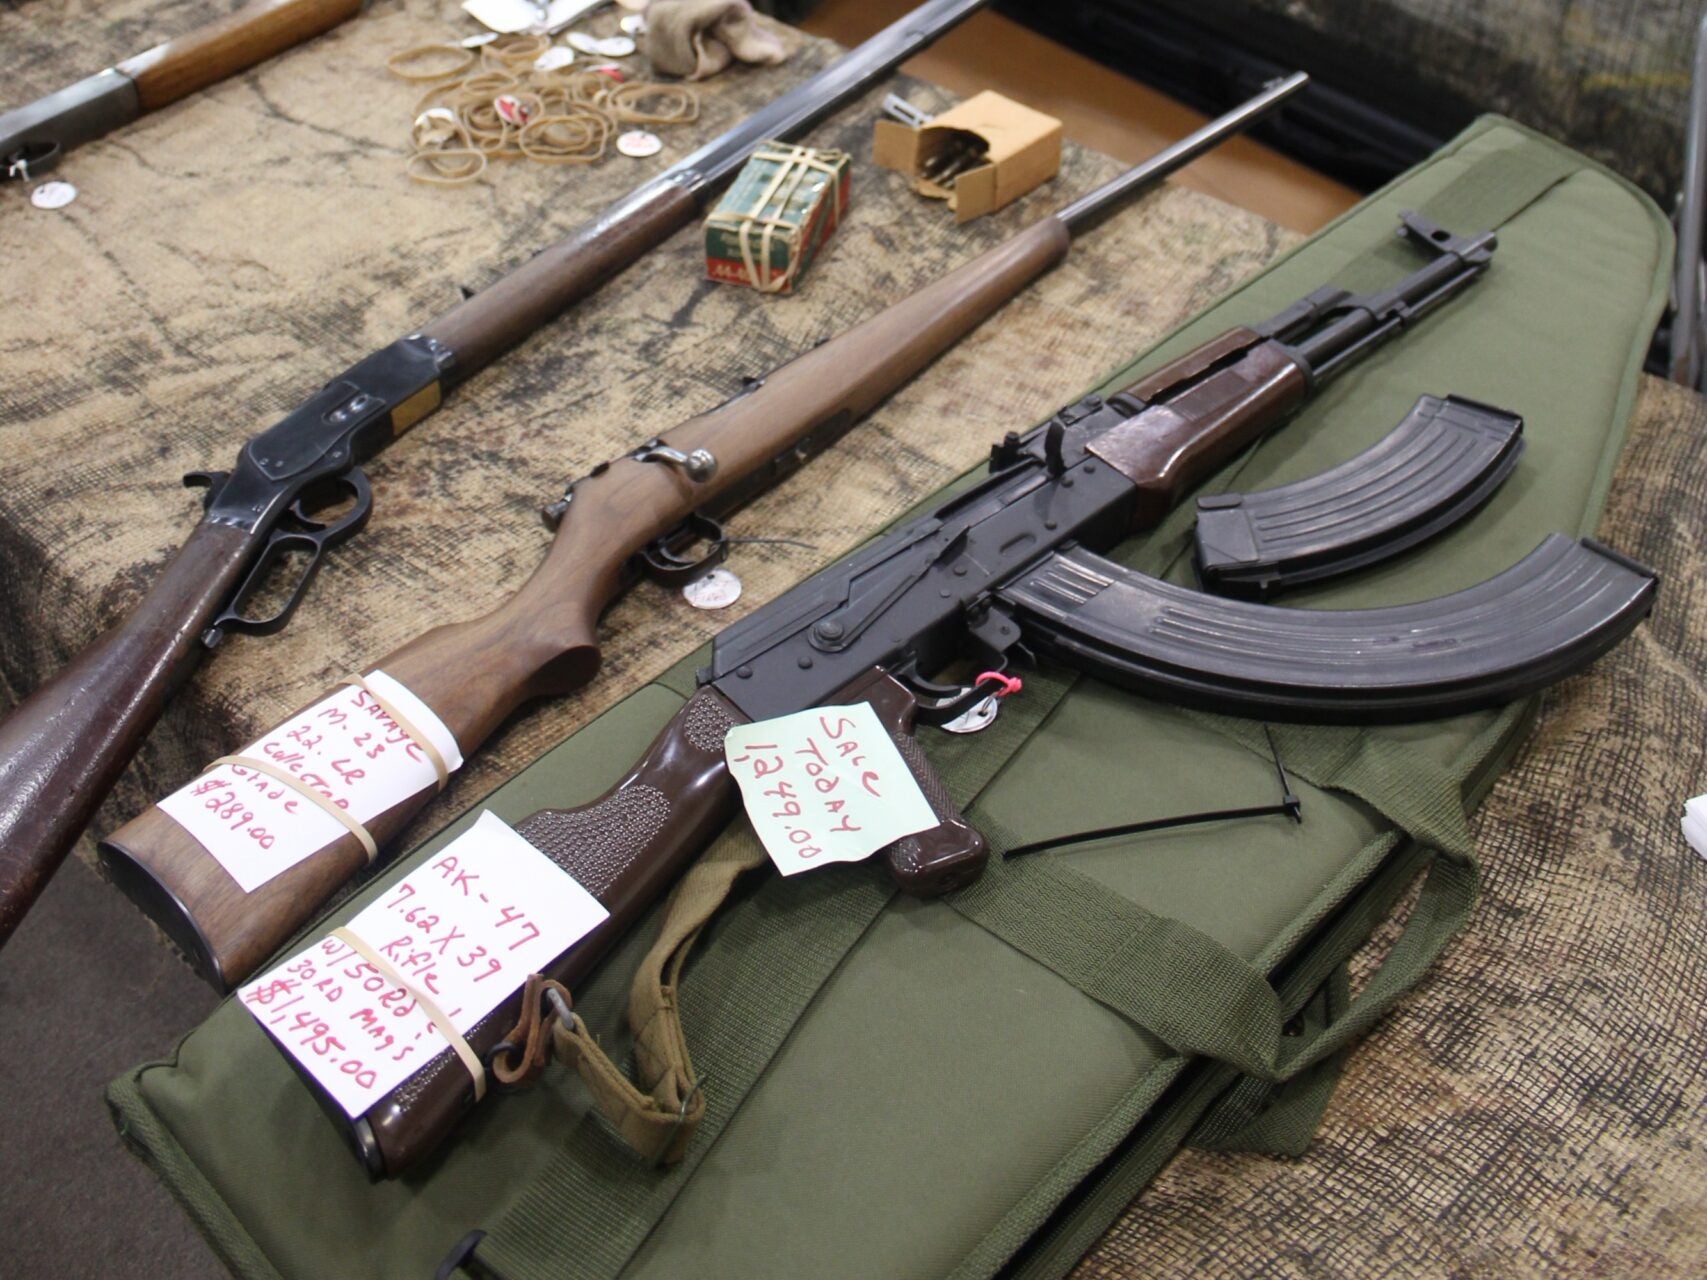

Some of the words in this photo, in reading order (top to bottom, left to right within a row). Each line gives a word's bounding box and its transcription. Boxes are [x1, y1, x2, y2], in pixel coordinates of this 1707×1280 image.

[330, 757, 366, 786] LR
[733, 743, 823, 859] 1,249.00
[189, 778, 276, 850] $289.00
[431, 855, 541, 951] AK-47
[378, 935, 440, 995] Rifle
[245, 978, 377, 1090] $1,495.00
